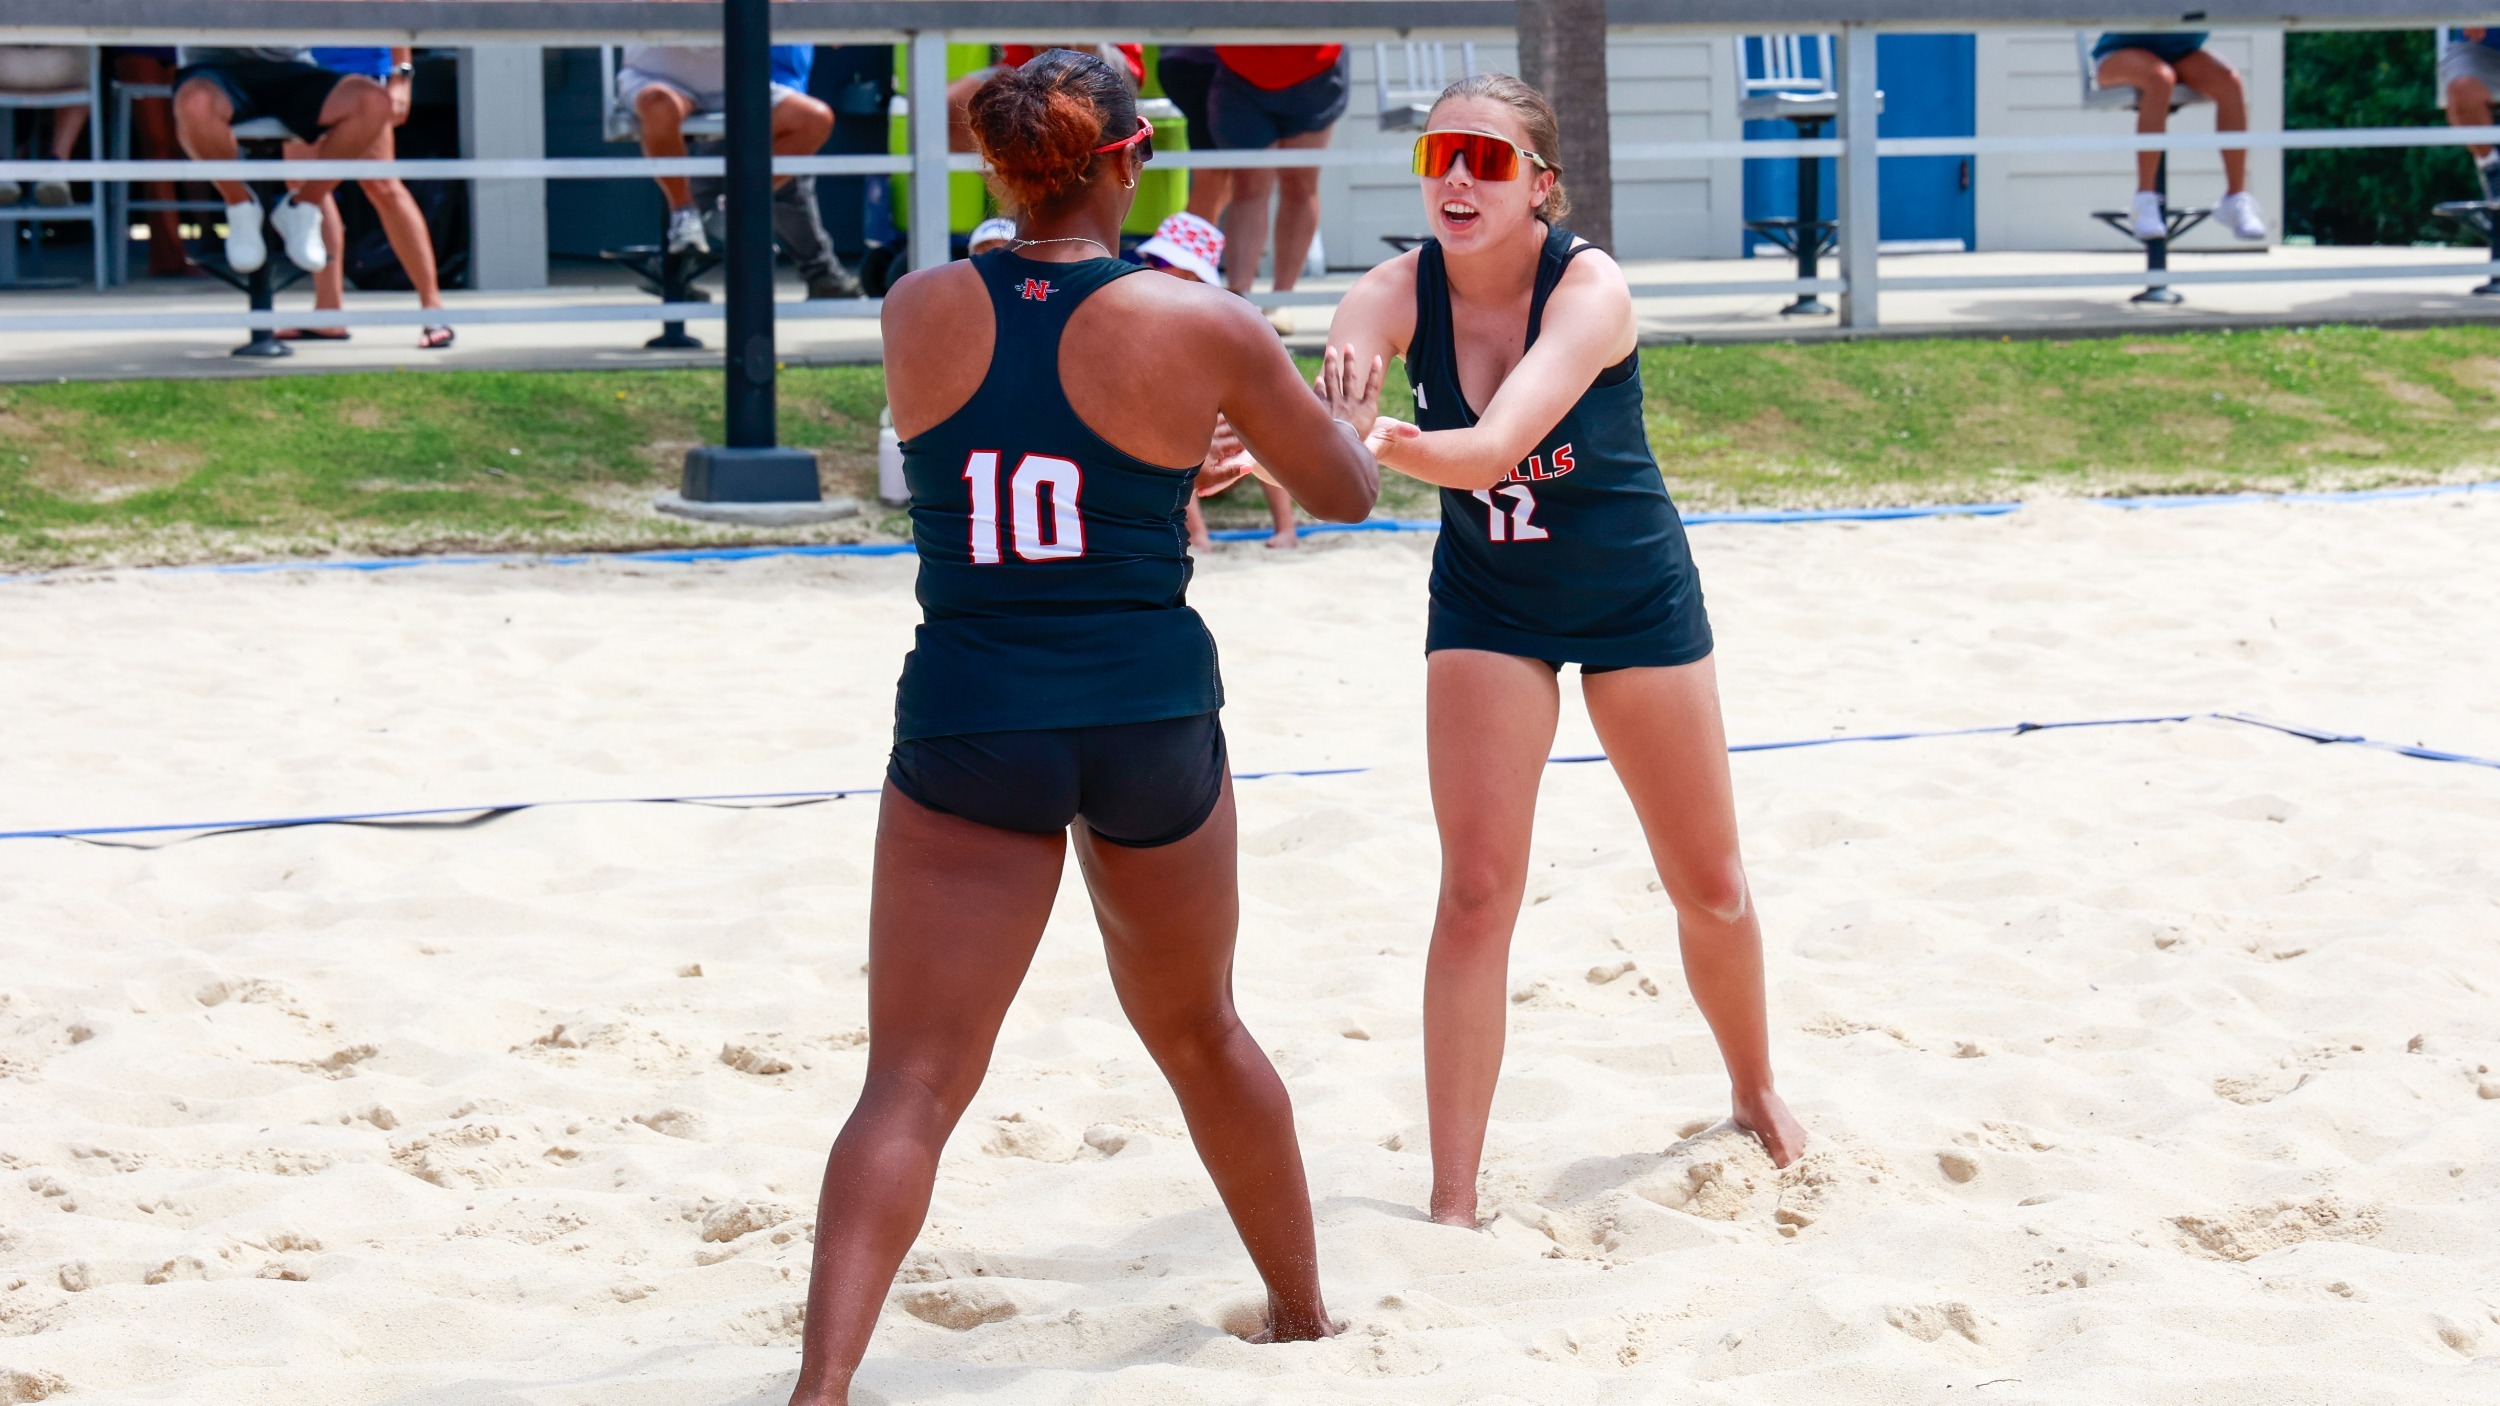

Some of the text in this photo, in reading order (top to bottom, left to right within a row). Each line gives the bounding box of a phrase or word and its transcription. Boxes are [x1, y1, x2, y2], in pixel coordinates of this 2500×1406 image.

[1021, 277, 1051, 302] N
[1499, 442, 1576, 483] LLS
[961, 449, 1088, 564] 10
[1472, 484, 1549, 543] 12
